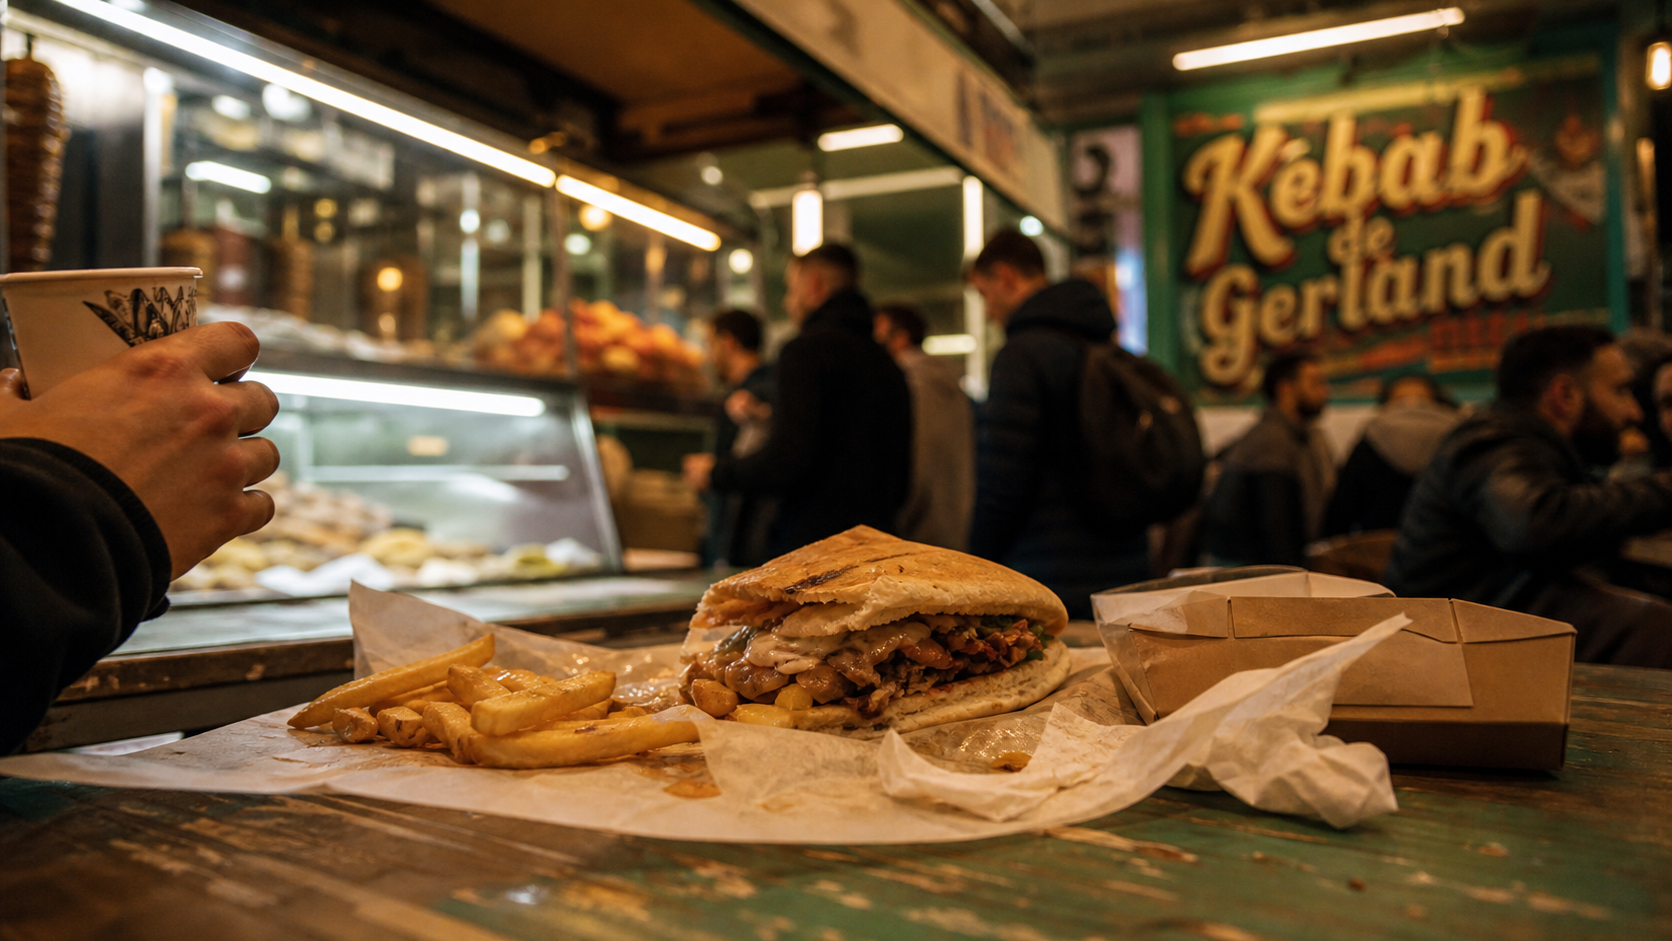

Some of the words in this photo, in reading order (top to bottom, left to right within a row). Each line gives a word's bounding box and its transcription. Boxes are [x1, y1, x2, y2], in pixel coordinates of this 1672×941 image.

[1181, 85, 1531, 274] Kébab
[1328, 206, 1396, 266] de
[1199, 188, 1552, 386] Gerland
